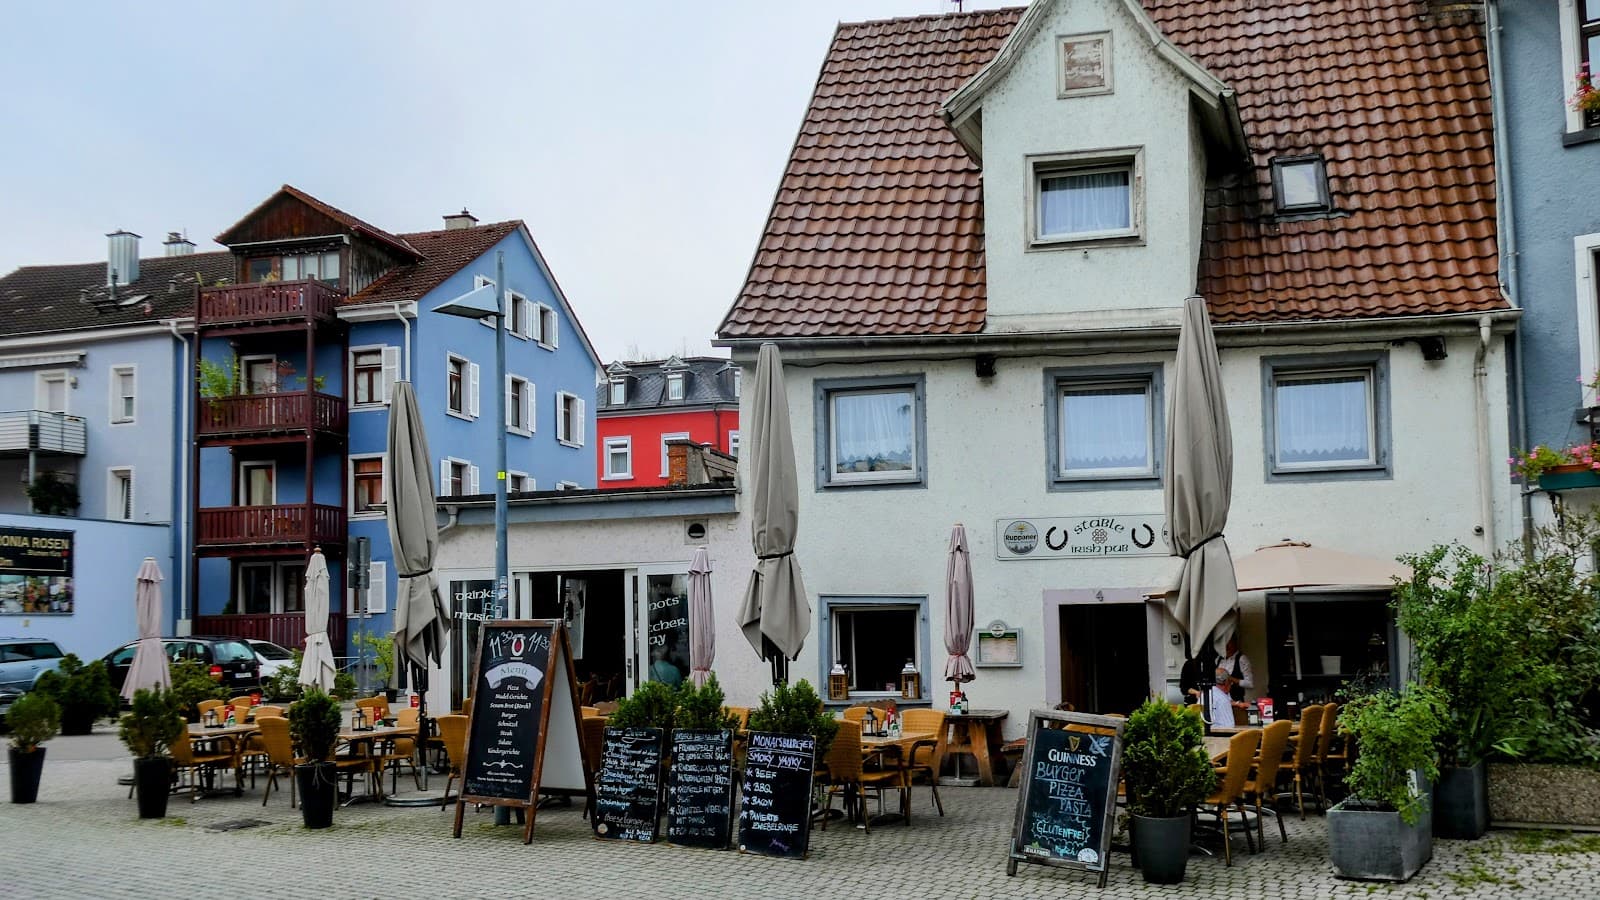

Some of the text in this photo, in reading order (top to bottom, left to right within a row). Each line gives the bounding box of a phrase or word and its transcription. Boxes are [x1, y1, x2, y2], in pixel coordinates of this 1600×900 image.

[0, 535, 69, 549] ONIA ROSEN
[1096, 590, 1104, 602] 4
[648, 633, 666, 646] ay
[748, 752, 774, 768] SMOKY
[1048, 748, 1098, 768] GUINNESS
[755, 768, 777, 779] BEEF
[1036, 761, 1085, 782] Burger
[753, 783, 772, 793] BBQ
[1049, 781, 1084, 799] PIZZA
[751, 796, 773, 807] BACON
[1060, 799, 1092, 814] PASTA
